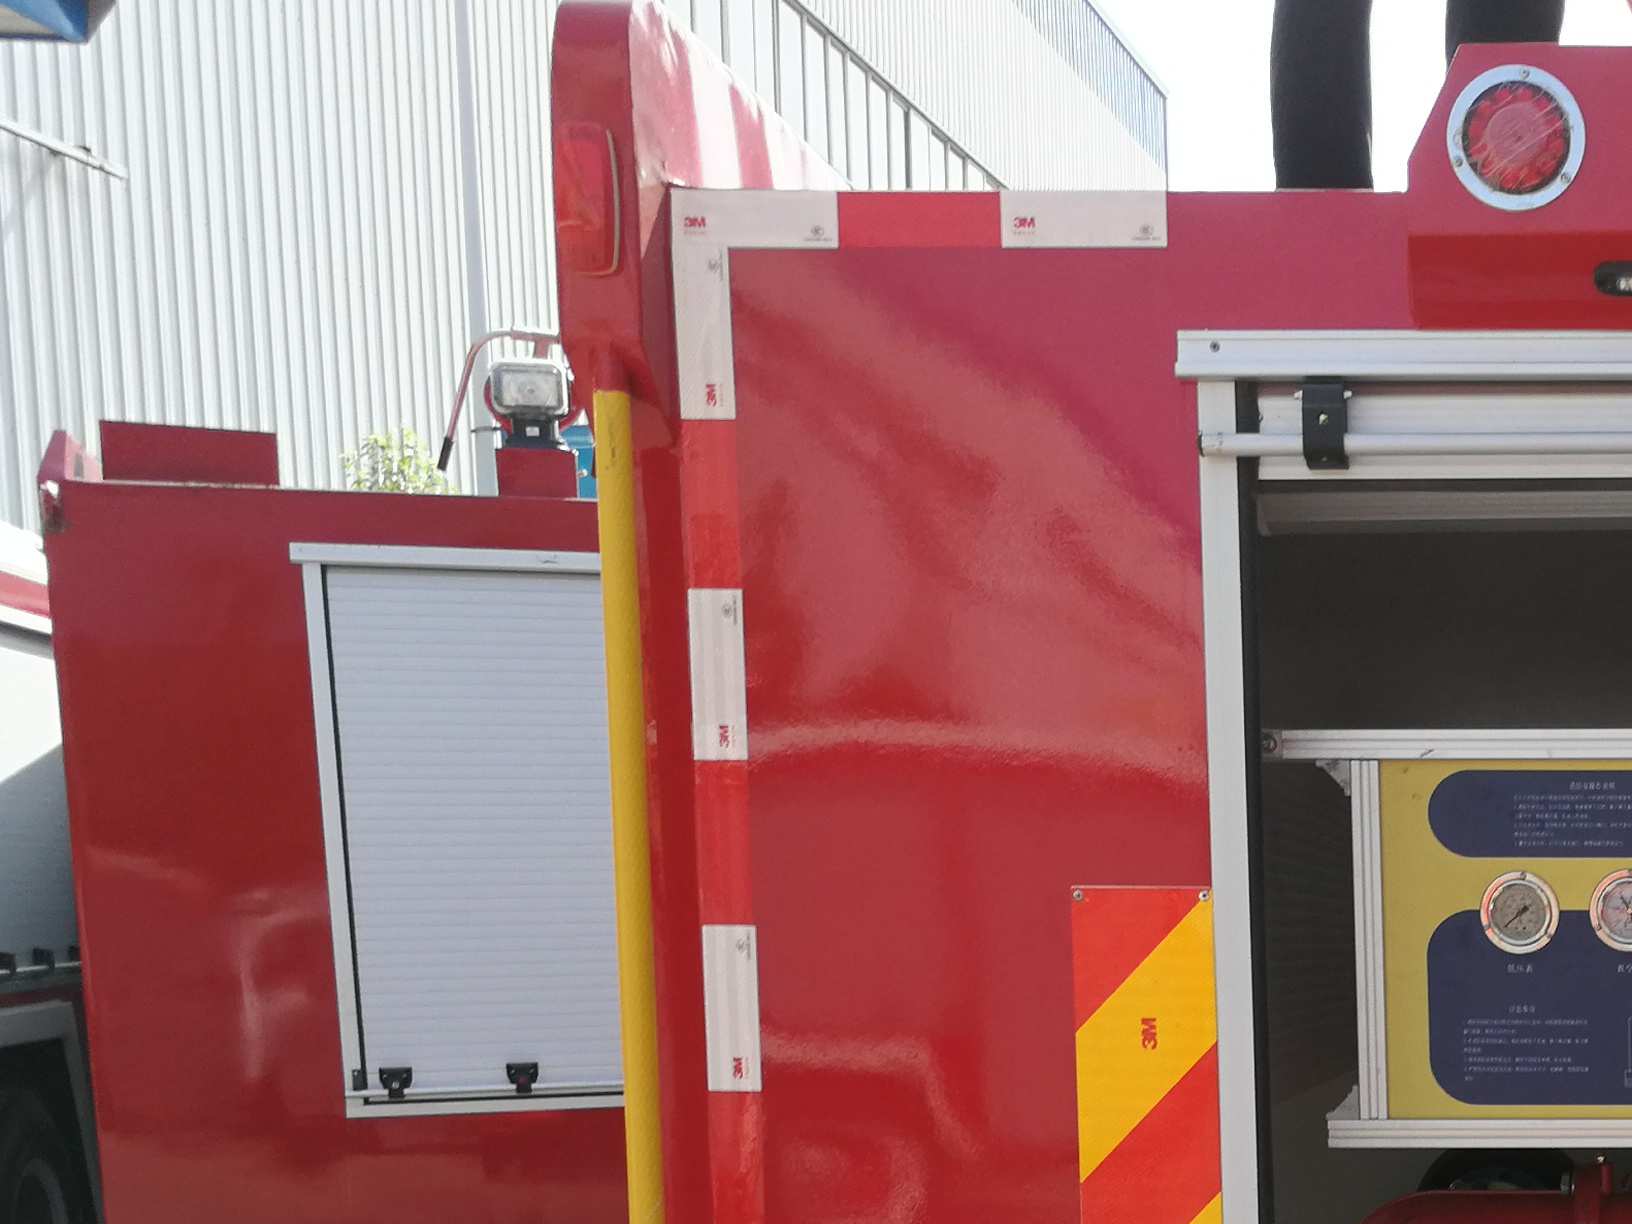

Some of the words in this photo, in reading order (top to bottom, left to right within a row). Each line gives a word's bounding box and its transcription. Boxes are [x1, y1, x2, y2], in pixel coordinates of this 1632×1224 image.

[684, 216, 707, 229] 3M
[1013, 216, 1037, 229] 3M
[705, 383, 718, 407] 3M
[718, 724, 730, 749] 3M
[1140, 1017, 1158, 1050] 3M
[733, 1057, 744, 1079] 3M
